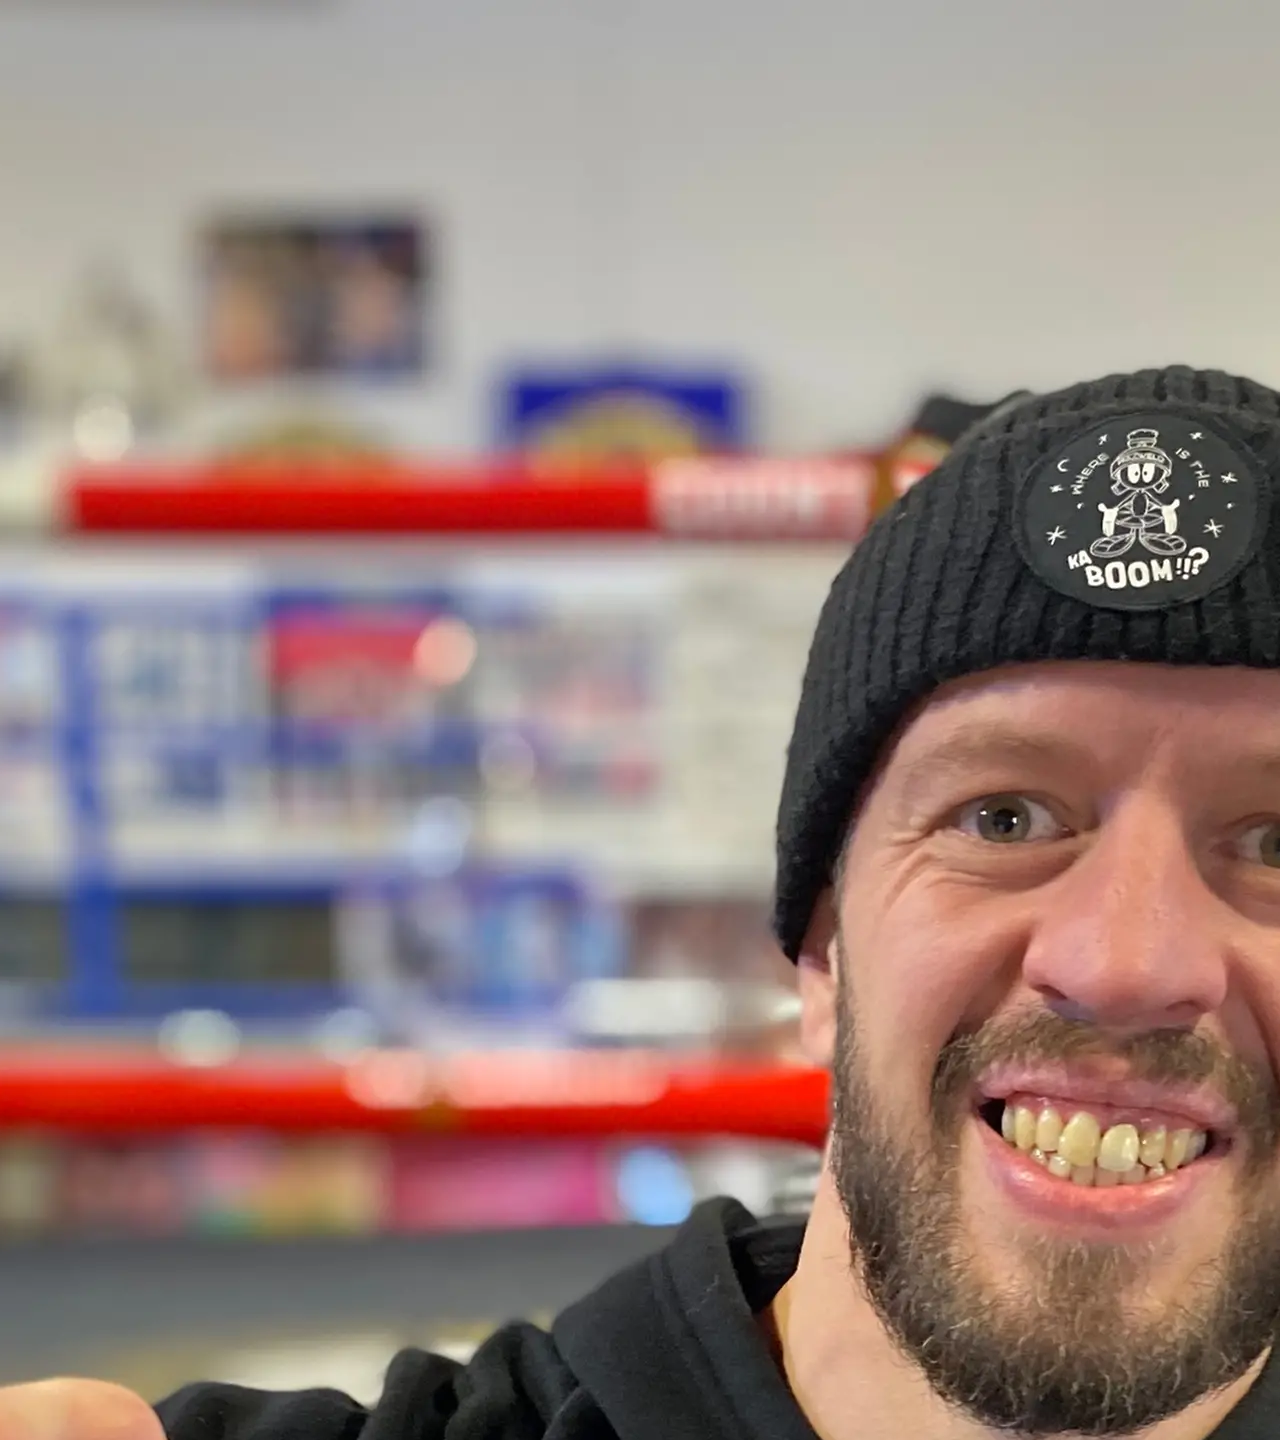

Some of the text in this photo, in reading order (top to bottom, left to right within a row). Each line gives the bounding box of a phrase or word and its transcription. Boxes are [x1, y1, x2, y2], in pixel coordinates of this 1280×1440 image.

[1070, 452, 1109, 495] WHERE
[1175, 447, 1190, 460] IS
[1189, 460, 1211, 488] THE
[1067, 550, 1092, 570] KA
